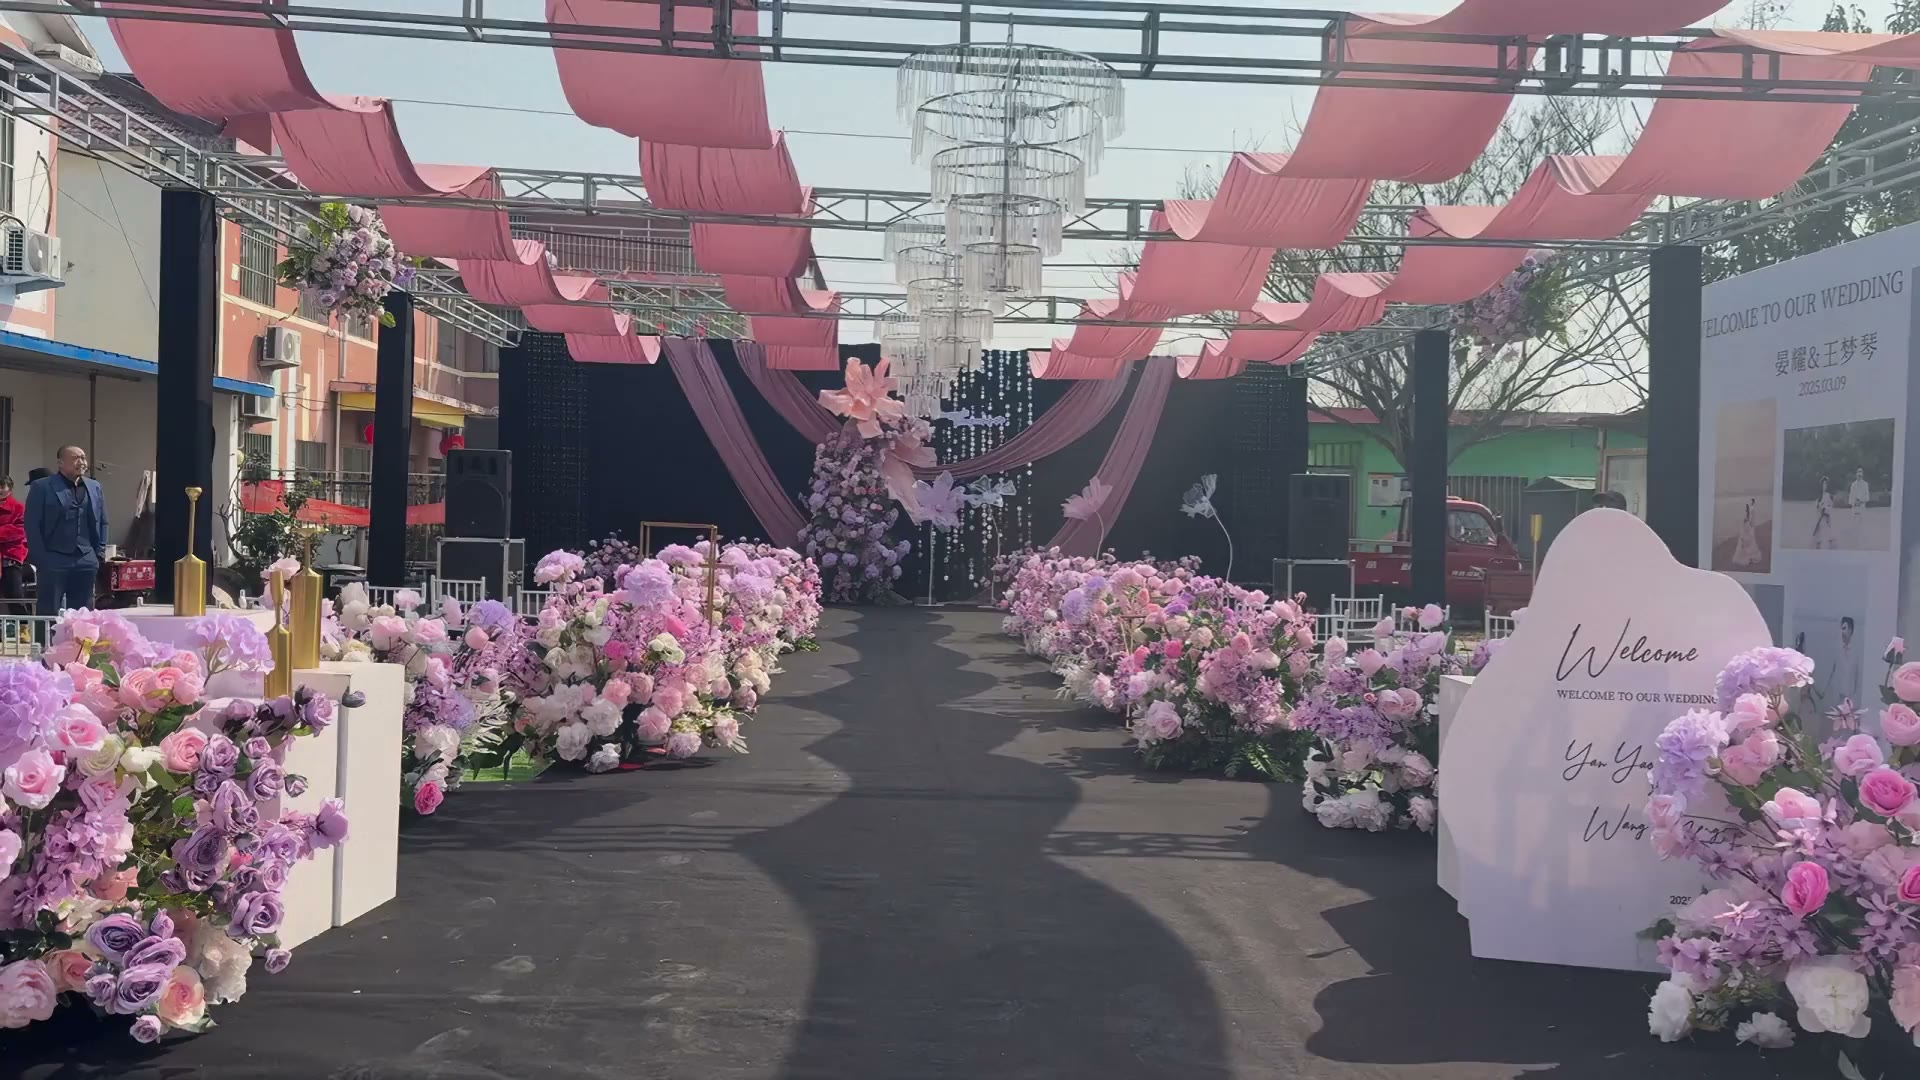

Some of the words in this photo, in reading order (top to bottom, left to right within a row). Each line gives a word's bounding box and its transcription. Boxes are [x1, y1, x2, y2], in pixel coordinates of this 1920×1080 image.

[1702, 307, 1760, 338] ELCOME
[1761, 301, 1781, 325] TO
[1784, 293, 1817, 320] OUR
[1821, 270, 1904, 309] WEDDING
[1797, 376, 1847, 397] 2025.03.09
[1556, 617, 1699, 682] Welcome
[1556, 689, 1615, 702] WELCOME
[1617, 691, 1633, 702] TO
[1636, 692, 1661, 703] OUR
[1562, 739, 1608, 782] Yan
[1611, 741, 1654, 784] Yao
[1583, 803, 1650, 842] Wang
